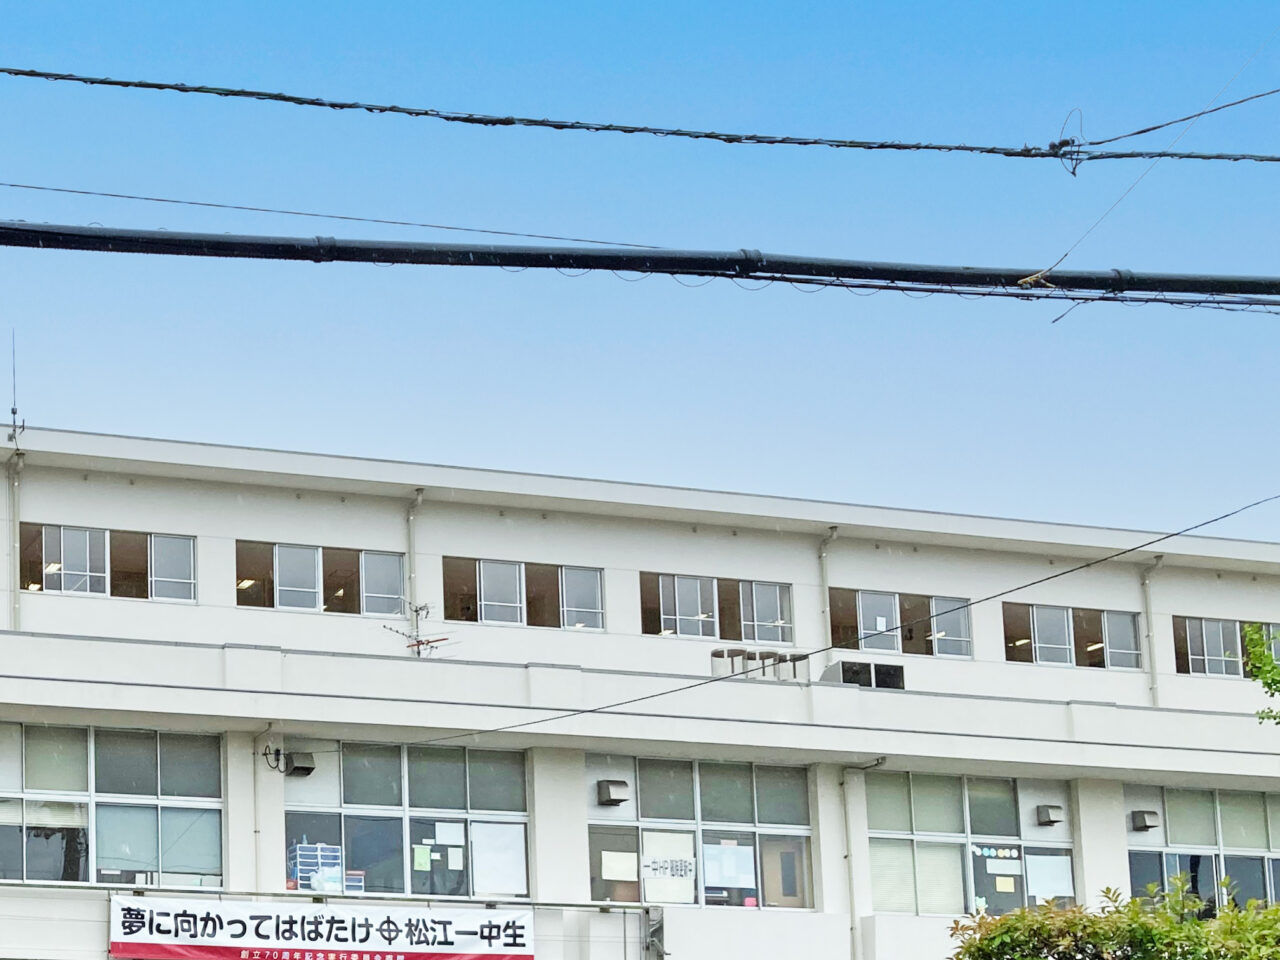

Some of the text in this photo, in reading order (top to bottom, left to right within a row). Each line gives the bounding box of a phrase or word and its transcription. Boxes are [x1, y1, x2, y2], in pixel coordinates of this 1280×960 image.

[120, 906, 527, 948] 夢に向かってはばたけ 松江一中生
